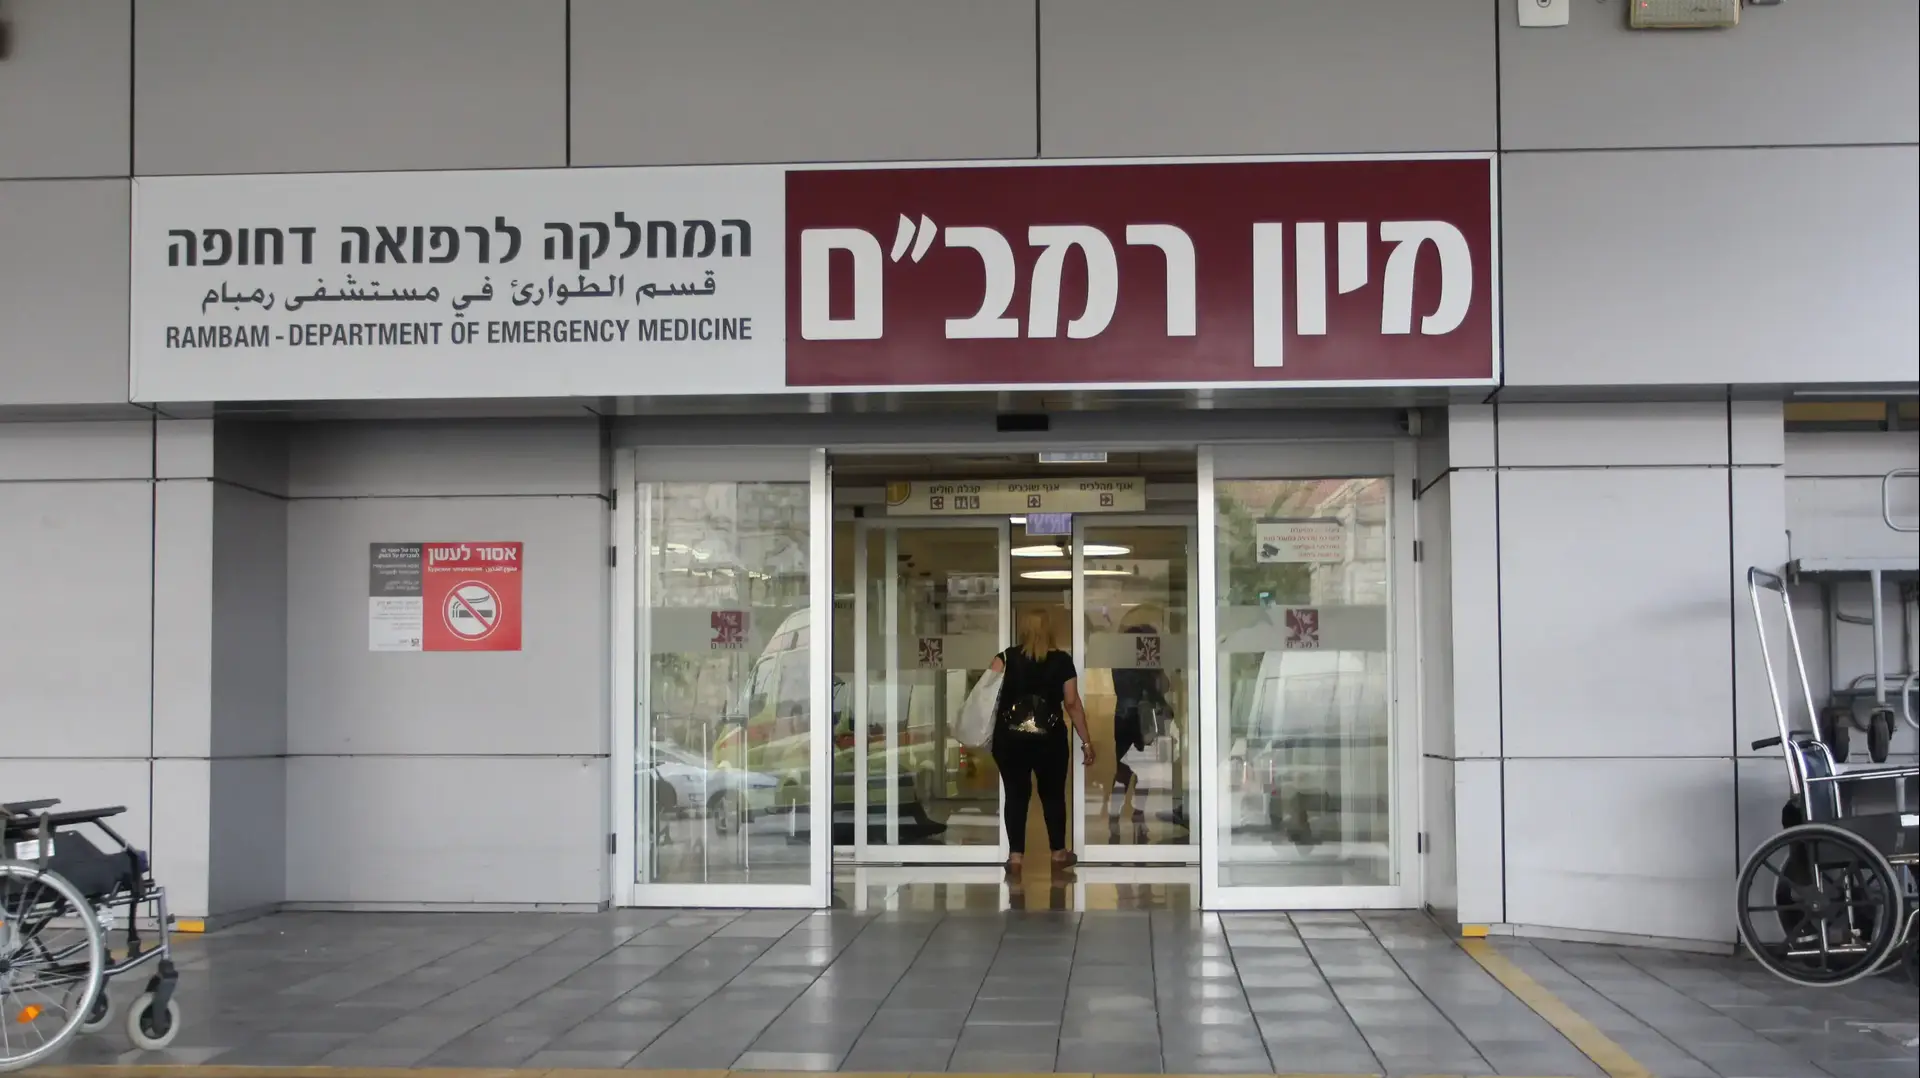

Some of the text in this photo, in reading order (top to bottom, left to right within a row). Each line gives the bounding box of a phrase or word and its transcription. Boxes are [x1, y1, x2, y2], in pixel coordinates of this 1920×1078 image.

[168, 211, 752, 270] המחלקה לרפואה דחופה
[201, 269, 717, 319] قسم الطوارئ في مستشفى رمبام
[1253, 219, 1473, 368] מיון
[165, 324, 270, 349] RAMBAM
[289, 322, 443, 347] DEPARTMENT
[450, 320, 480, 345] OF
[487, 318, 630, 344] EMERGENCY
[638, 316, 753, 342] MEDICINE
[928, 484, 954, 494] חולים
[428, 543, 517, 566] אסור לעשן
